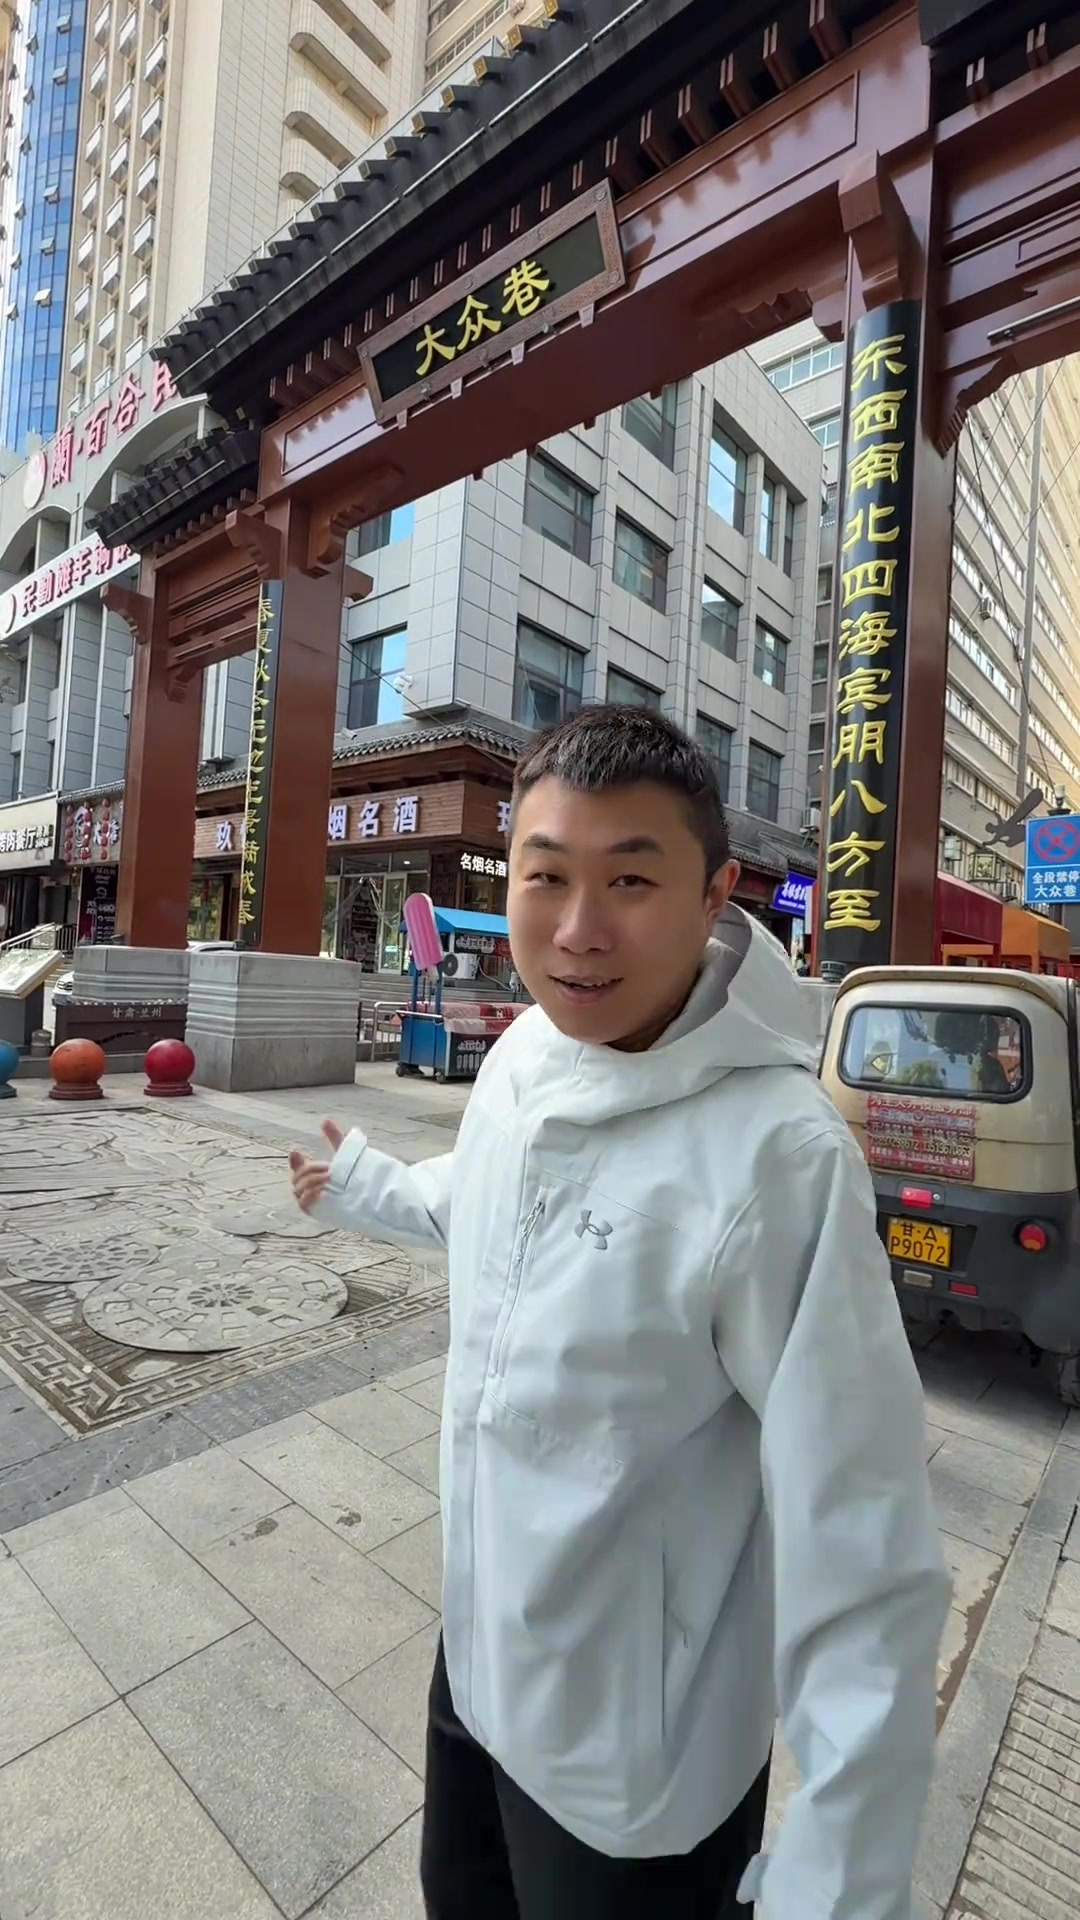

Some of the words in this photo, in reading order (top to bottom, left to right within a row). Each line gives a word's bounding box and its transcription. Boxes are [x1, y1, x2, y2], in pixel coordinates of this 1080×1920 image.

[415, 260, 550, 376] 大众巷
[823, 334, 908, 932] 东西南北四海宾朋八方至
[460, 853, 507, 877] 名烟名酒
[1032, 870, 1080, 885] 全段禁停
[1034, 884, 1077, 898] 大众巷
[890, 1235, 946, 1264] P9072
